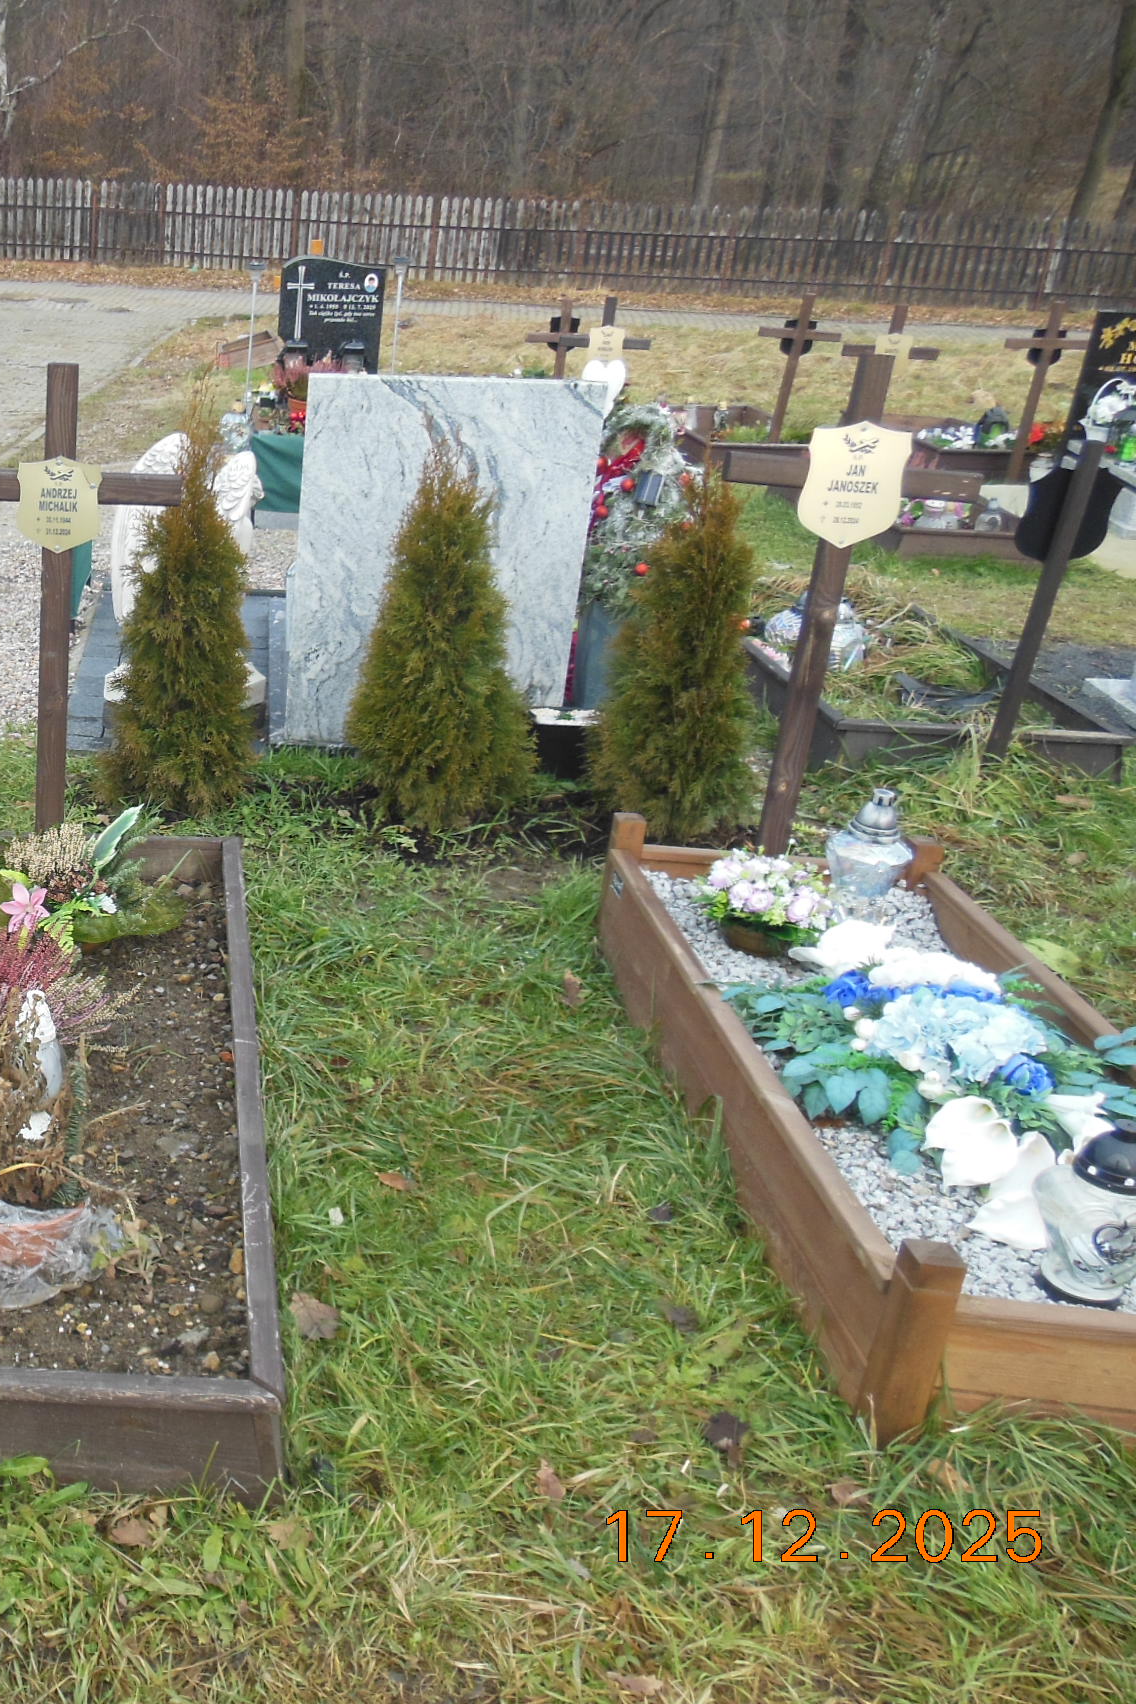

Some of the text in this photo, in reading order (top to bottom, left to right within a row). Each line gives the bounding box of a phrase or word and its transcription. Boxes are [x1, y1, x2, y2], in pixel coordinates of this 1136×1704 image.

[327, 282, 361, 290] TERESA
[307, 293, 379, 303] MIKOŁAJCZYK
[846, 464, 867, 477] JAN
[827, 480, 879, 494] JANOSZEK
[40, 488, 78, 500] ANDRZEJ
[38, 501, 78, 513] MICHALIK
